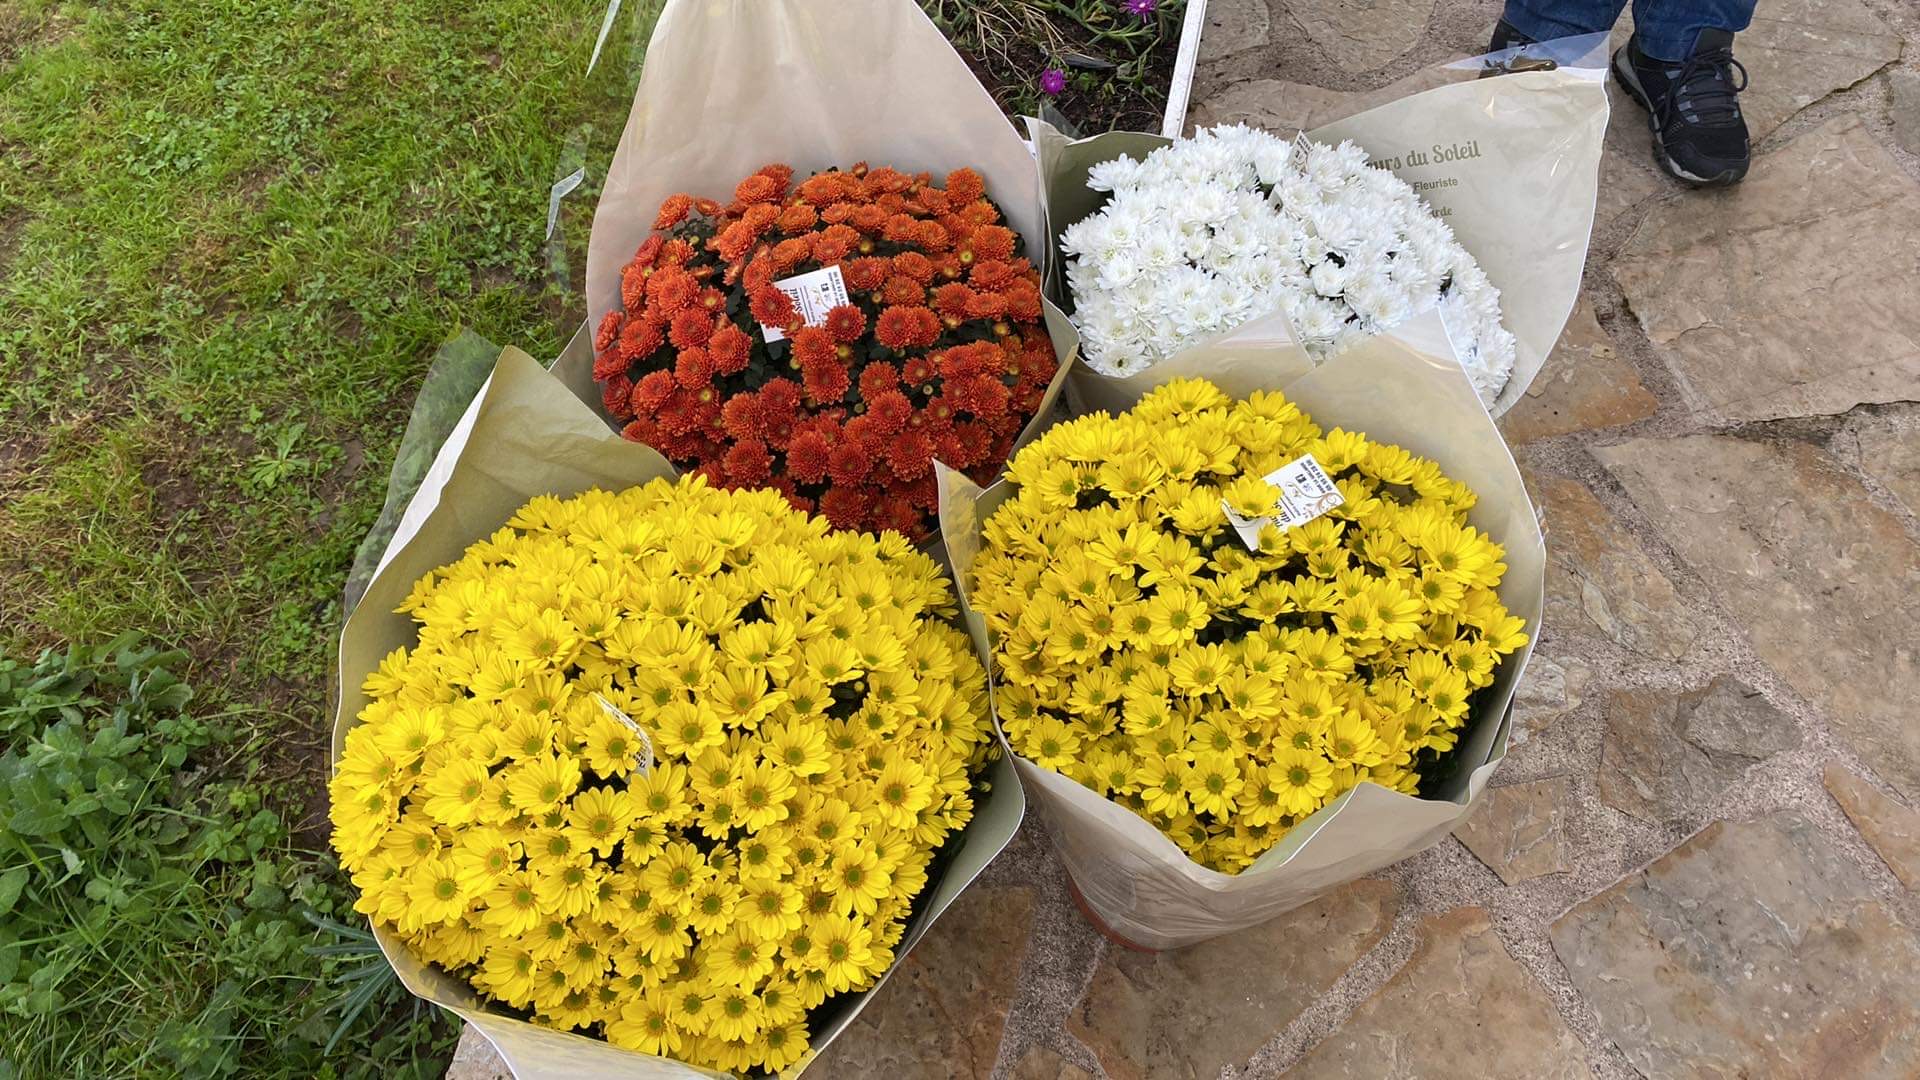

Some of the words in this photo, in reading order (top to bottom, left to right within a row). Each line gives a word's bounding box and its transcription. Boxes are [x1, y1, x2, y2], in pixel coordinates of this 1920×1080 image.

[1406, 149, 1429, 169] du
[1432, 140, 1482, 165] Soleil
[1413, 176, 1459, 192] Fleuriste
